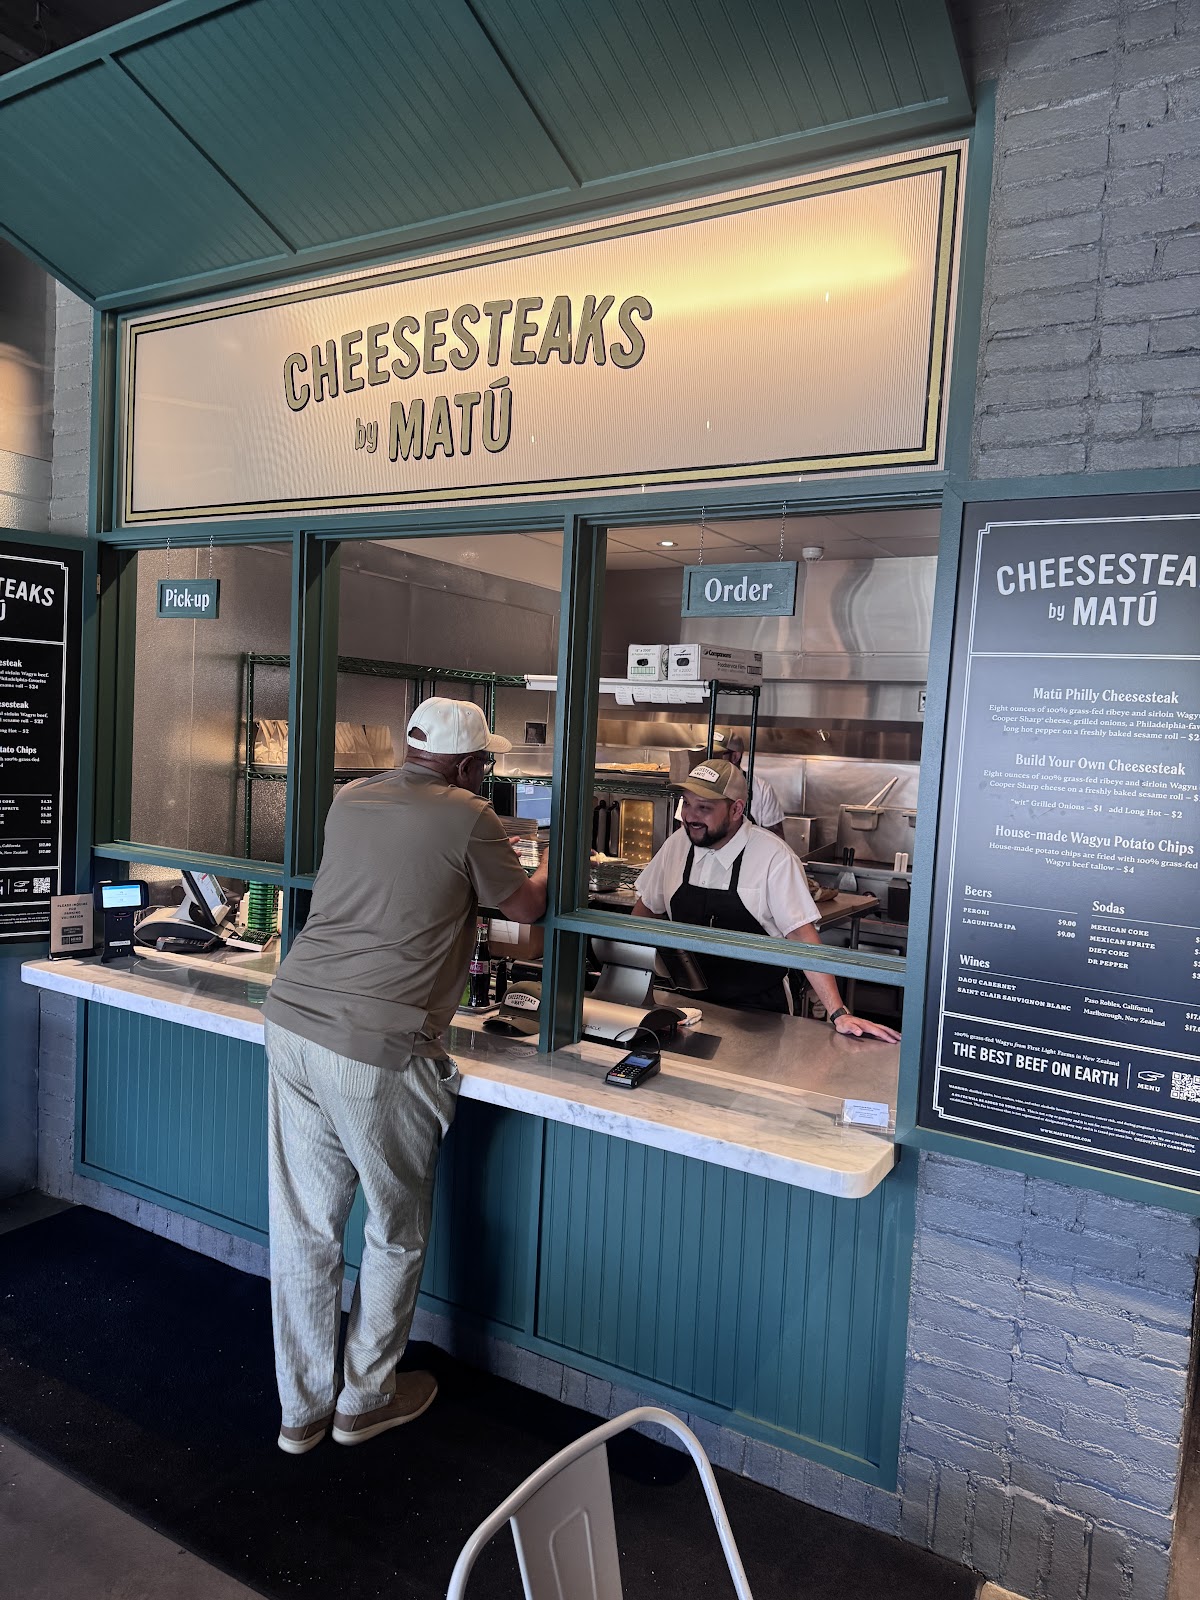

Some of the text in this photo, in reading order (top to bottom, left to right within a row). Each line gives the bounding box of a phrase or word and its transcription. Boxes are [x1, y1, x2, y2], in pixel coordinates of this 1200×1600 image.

[284, 295, 653, 412] CHEESESTEAKS
[355, 376, 512, 462] by MATÚ
[996, 552, 1200, 596] CHEESESTEA
[704, 576, 773, 602] Order
[166, 588, 210, 611] Pick-up
[1048, 590, 1157, 626] by MATÚ
[1065, 688, 1099, 704] Philly
[1102, 690, 1179, 704] Cheesesteak
[992, 715, 1018, 723] Cooper
[1073, 718, 1098, 726] grilled
[1106, 709, 1130, 717] ribeye
[1148, 710, 1174, 718] sirloin
[1003, 725, 1019, 733] long
[1080, 728, 1107, 738] freshly
[1188, 733, 1200, 741] $2
[1016, 754, 1186, 775] Build Your Own Cheesesteak
[984, 770, 1002, 778] Eight
[1100, 778, 1124, 786] ribeye
[1125, 779, 1140, 787] and
[1170, 782, 1197, 792] Wagyu
[990, 780, 1015, 789] Cooper
[1017, 782, 1039, 791] Sharp
[1041, 784, 1065, 792] cheese
[1085, 787, 1111, 796] freshly
[1114, 789, 1136, 797] baked
[1031, 799, 1057, 808] Grilled
[1058, 802, 1084, 810] Onions
[1094, 804, 1102, 812] $1
[1125, 808, 1145, 816] Long
[995, 825, 1194, 856] House-made Wagyu Potato Chips
[989, 842, 1034, 853] House-made
[1061, 850, 1081, 858] chips
[1097, 853, 1115, 861] fried
[1160, 860, 1198, 869] grass-fed
[1045, 858, 1134, 874] Wagyu beef tallow $4
[964, 885, 993, 898] Beers
[963, 907, 990, 916] PERONI
[1092, 901, 1125, 914] Sodas
[962, 918, 1002, 928] LAGUNITAS
[1058, 919, 1077, 927] $9.00
[1090, 924, 1126, 934] MEXICAN
[1057, 930, 1076, 938] $9.00
[1090, 935, 1156, 950] MEXICAN SPRITE
[1088, 946, 1129, 958] DIET COKE
[960, 954, 990, 969] Wines
[1100, 960, 1129, 969] PEPPER
[958, 976, 1016, 991] DAOU CABERNET
[957, 987, 1072, 1011] SAINT CLAIR SAUVIGNON BLANC
[1100, 999, 1122, 1009] Robles,
[1122, 1003, 1154, 1013] California
[1083, 1008, 1165, 1027] Marlborough, New Zealand
[1186, 1012, 1200, 1020] $17.
[1027, 1044, 1040, 1052] First
[1041, 1047, 1056, 1055] Light
[1096, 1057, 1120, 1066] Zealand
[953, 1042, 1119, 1087] THE BEST BEEF ON EARTH
[1137, 1083, 1161, 1092] MENU
